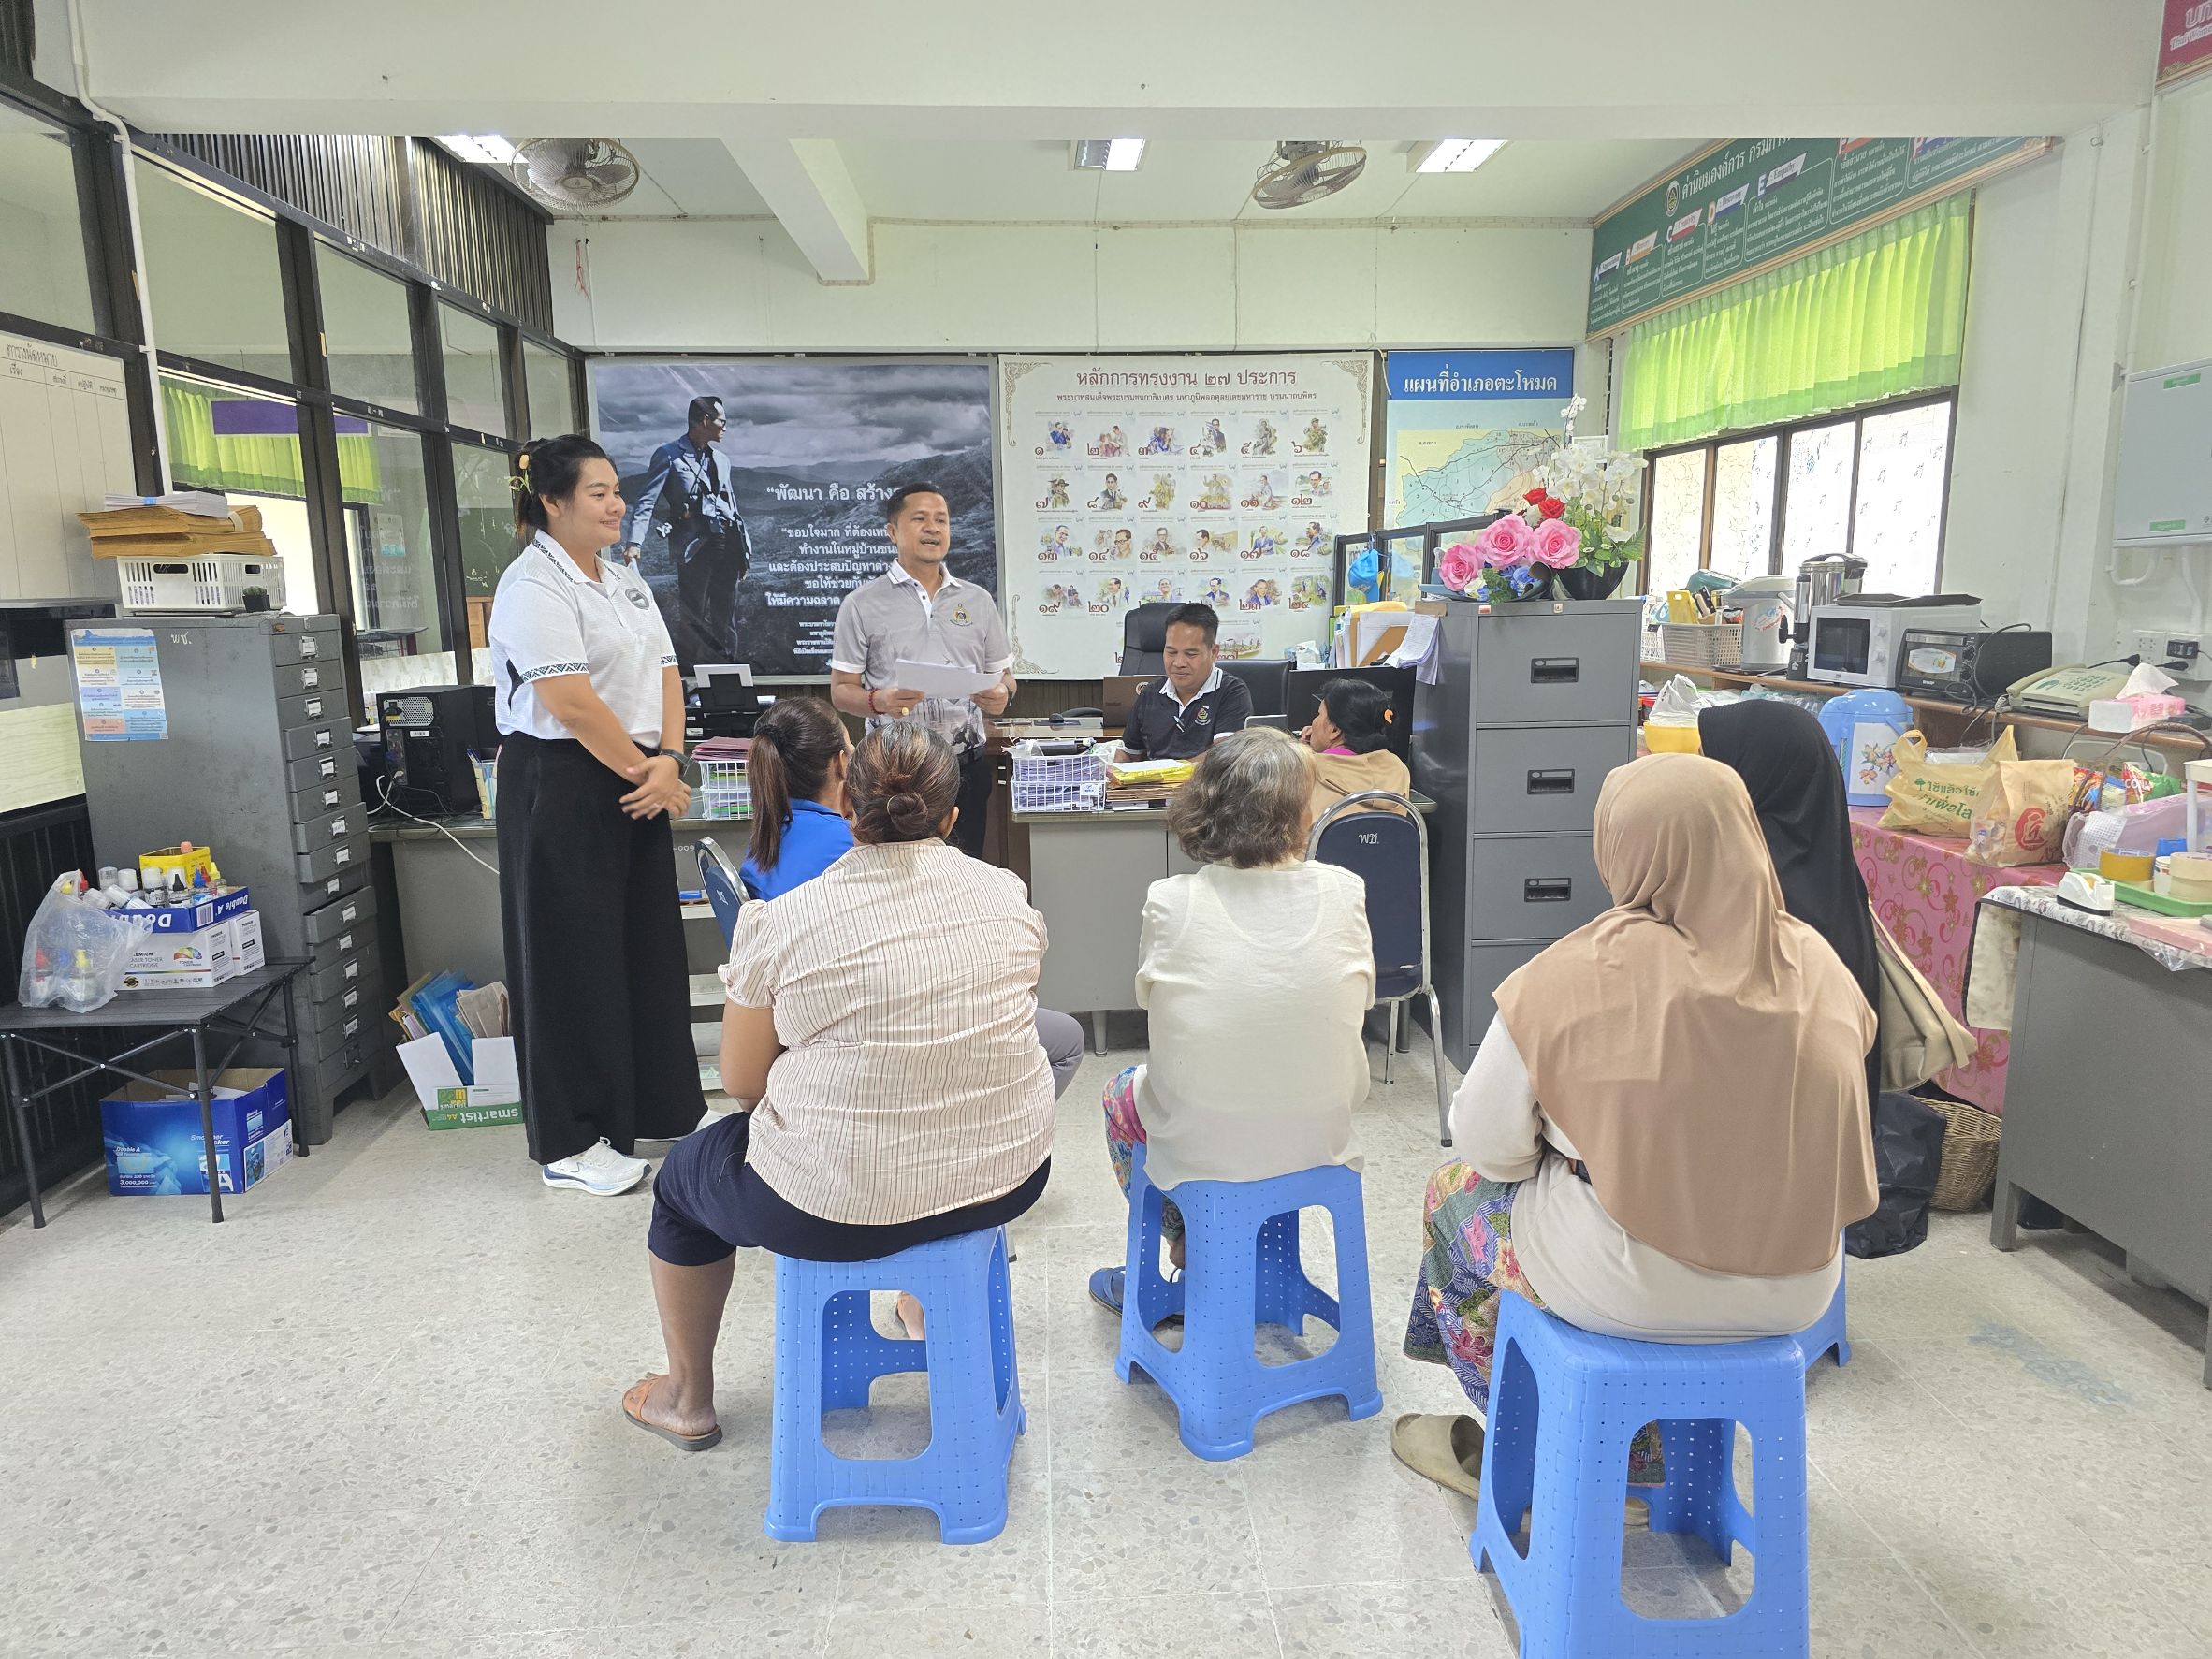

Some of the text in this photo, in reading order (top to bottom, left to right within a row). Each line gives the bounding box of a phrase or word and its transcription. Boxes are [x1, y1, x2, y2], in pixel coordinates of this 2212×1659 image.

[1681, 150, 1746, 200] ค่านิยมองค์การ
[1758, 173, 1767, 196] E
[1708, 200, 1716, 226] D
[1666, 225, 1673, 243] C
[1593, 263, 1600, 284] A
[1076, 367, 1297, 386] หลักการทรงงาน ๒๗ ประการ
[1404, 363, 1558, 393] แผนที่อำเภอตะโหมด
[1034, 446, 1044, 457] ๑
[1086, 443, 1100, 456] ๒
[1189, 437, 1202, 456] ๔
[1291, 440, 1303, 454] ๖
[766, 482, 822, 502] “พัฒนา
[829, 481, 850, 501] คือ
[1035, 497, 1049, 509] ๗
[1138, 497, 1151, 509] ๙
[1189, 500, 1209, 510] ๑๐
[1240, 499, 1259, 509] ๑๑
[1290, 494, 1313, 506] ๑๒
[1088, 549, 1110, 561] ๑๔
[1189, 547, 1210, 561] ๑๖
[1240, 547, 1263, 560] ๑๗
[1290, 547, 1311, 559] ๑๘
[768, 560, 892, 575] และต้องประสบปัญหาต่า
[765, 591, 841, 607] ให้มีความฉลาด
[1239, 599, 1263, 611] ๒๓
[1288, 597, 1312, 610] ๒๔
[1038, 601, 1062, 614] ๑๙
[1088, 600, 1110, 613] ๒๐
[1927, 780, 1963, 794] ใช้แล้ว
[217, 895, 249, 915] Double A
[459, 1108, 519, 1124] smartist
